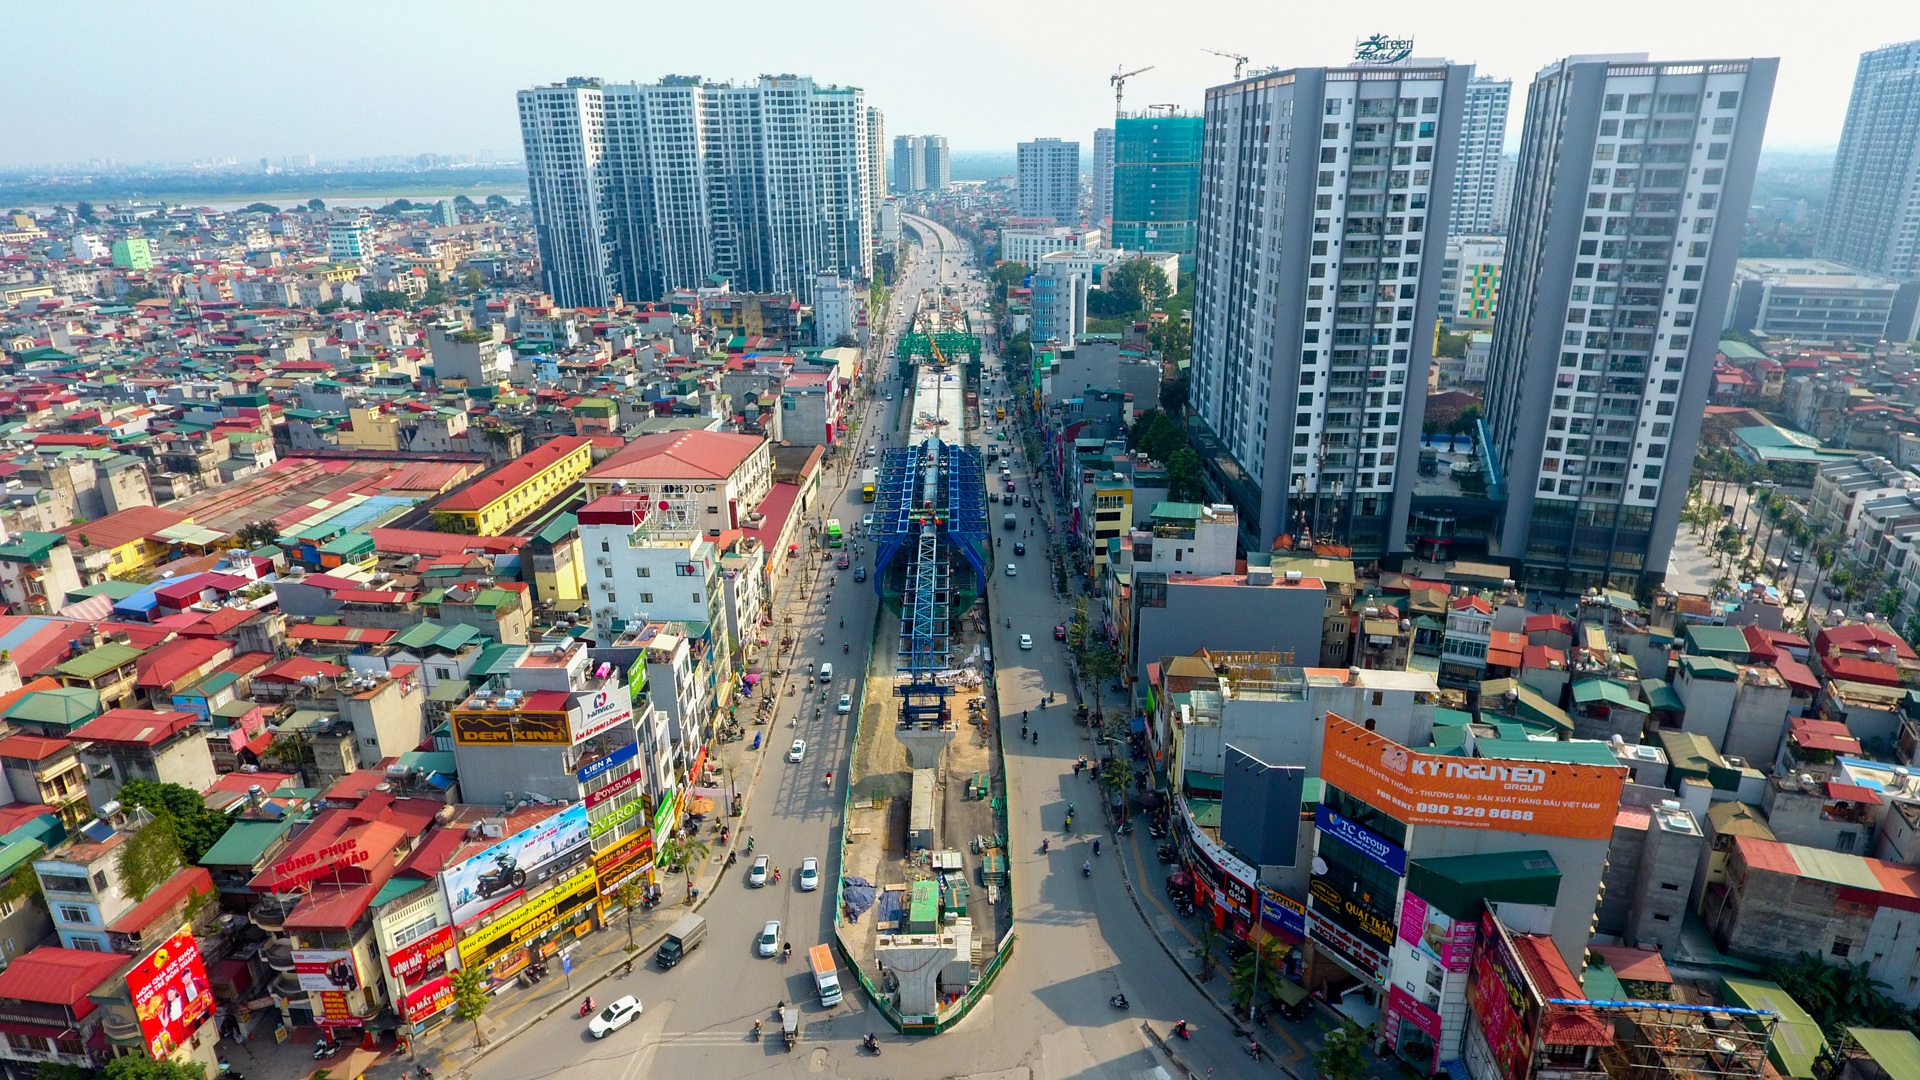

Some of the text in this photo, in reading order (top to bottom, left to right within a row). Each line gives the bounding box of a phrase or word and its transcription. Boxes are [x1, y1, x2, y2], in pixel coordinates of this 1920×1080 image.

[601, 777, 631, 798] OYASUMI
[1503, 784, 1543, 792] GROUP
[1377, 789, 1415, 812] FOR RENT:
[591, 798, 642, 837] EVERON
[1417, 803, 1534, 821] 090 329 8688
[1341, 820, 1356, 834] TC
[1358, 830, 1389, 854] Group
[1228, 889, 1247, 904] GÓP
[1229, 880, 1246, 898] TRẢ
[1272, 893, 1301, 912] JOTUN
[510, 907, 557, 943] REMAX
[1313, 922, 1350, 951] VICTORY
[1413, 1007, 1432, 1025] Beauty
